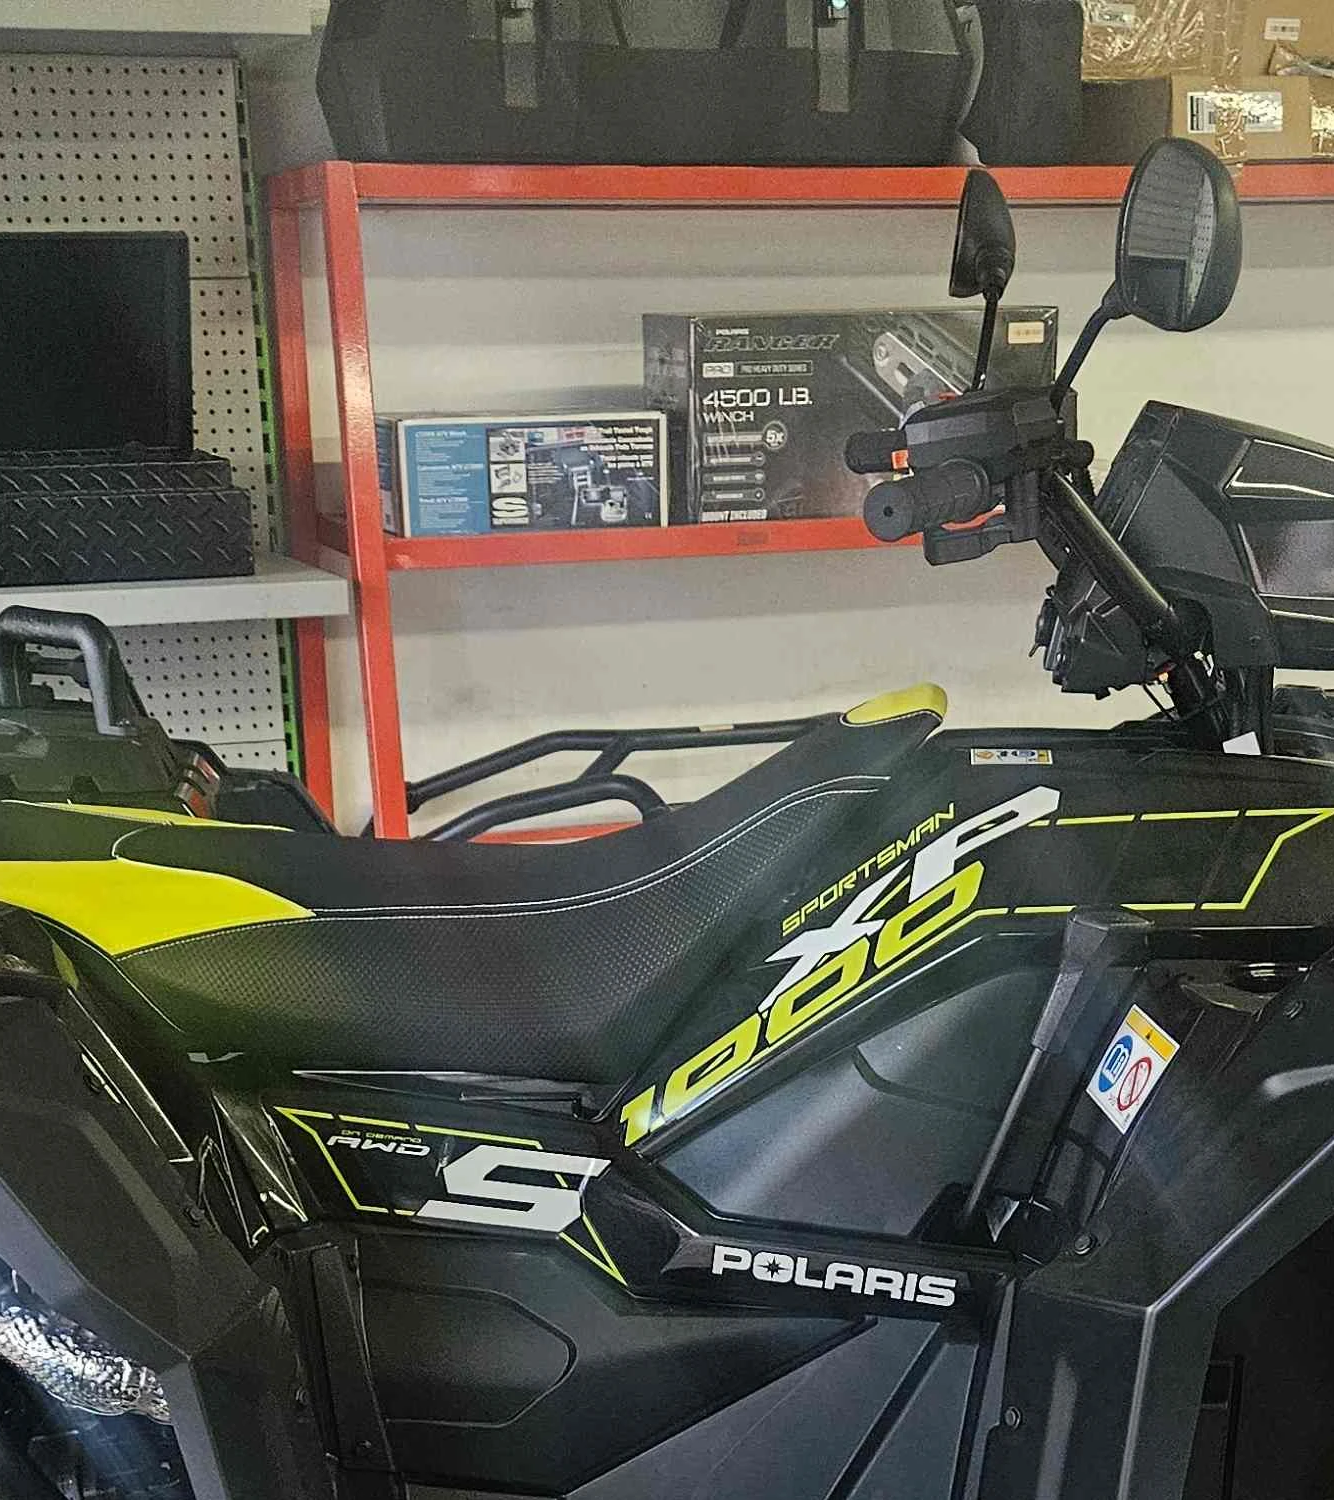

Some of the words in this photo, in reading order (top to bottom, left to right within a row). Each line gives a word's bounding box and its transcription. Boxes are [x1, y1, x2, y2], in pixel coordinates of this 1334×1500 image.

[704, 335, 840, 352] RANGER
[703, 388, 771, 408] 4500
[778, 387, 814, 405] LB.
[703, 410, 755, 425] WINCH
[782, 802, 955, 937] SPORTSMAN
[756, 785, 1061, 1014] XP
[620, 860, 985, 1147] 1000
[326, 1135, 431, 1157] AWD
[712, 1244, 956, 1307] POLARIS
